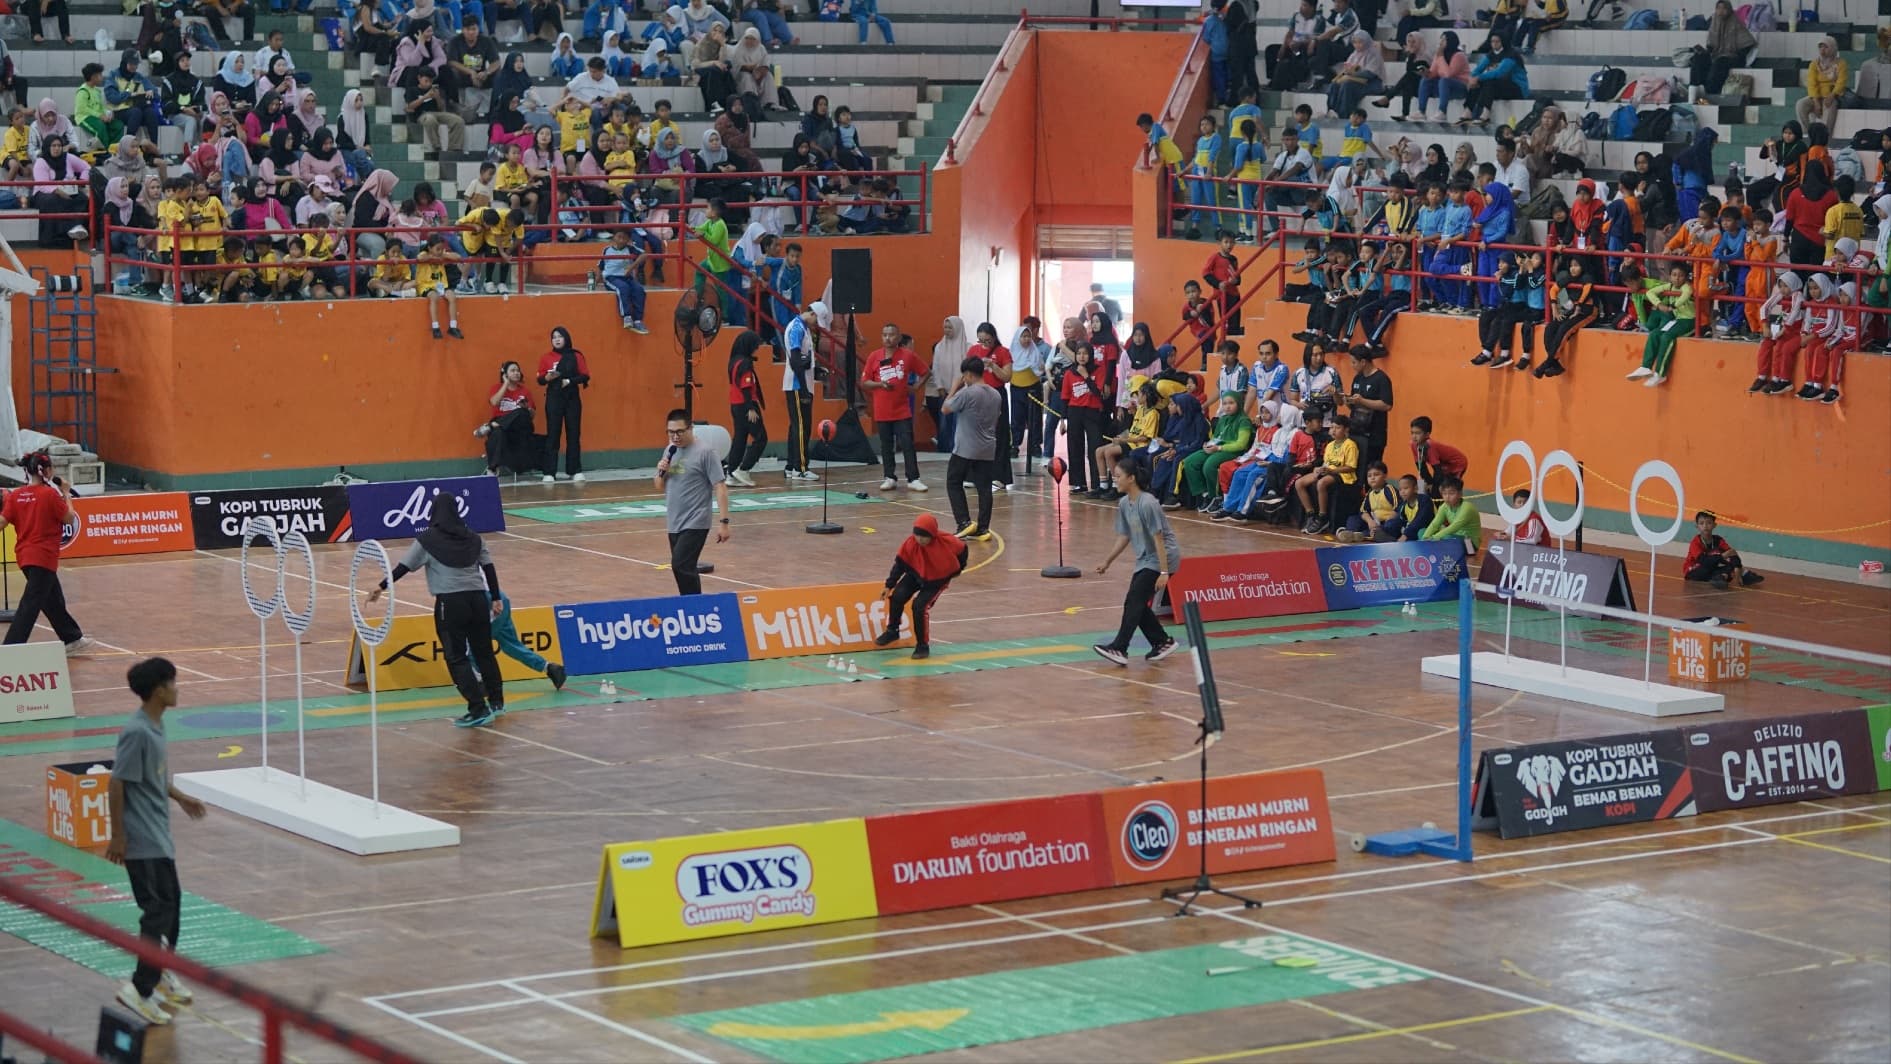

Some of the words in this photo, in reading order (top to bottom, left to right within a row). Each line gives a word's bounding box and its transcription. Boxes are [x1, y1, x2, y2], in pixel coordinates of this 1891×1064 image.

[88, 512, 139, 524] BENERAN
[141, 510, 178, 521] MURNI
[220, 501, 257, 514] KOPI
[259, 497, 323, 512] TUBRUK
[86, 525, 138, 537] BENERAN
[140, 522, 183, 534] RINGAN
[221, 512, 326, 536] GAJAH
[1238, 579, 1311, 599] foundation
[577, 609, 723, 650] hydroplus
[666, 645, 702, 655] ISOTONIC
[703, 642, 727, 652] DRINK
[1672, 636, 1704, 660] Milk
[1712, 638, 1745, 660] Milk
[1677, 656, 1705, 679] Life
[1717, 657, 1747, 679] Life
[1753, 724, 1803, 743] DELIZIO
[1566, 748, 1598, 765] KOPI
[1599, 742, 1654, 760] TUBRUK
[1569, 755, 1659, 786] GADJAH
[48, 786, 73, 818] Milk
[1573, 790, 1617, 807] BENAR
[1620, 785, 1662, 801] BENAR
[1187, 802, 1259, 825] BENERAN
[1261, 797, 1309, 817] MURNI
[1605, 803, 1636, 817] KOPI
[53, 812, 74, 842] Life
[1133, 823, 1169, 850] Cleo
[1187, 824, 1258, 846] BENERAN
[1259, 817, 1317, 837] RINGAN
[951, 835, 979, 849] Bakti
[980, 830, 1027, 846] Olahraga
[893, 855, 973, 884] DJARUM
[976, 840, 1090, 874] foundation
[692, 855, 799, 898] FOX'S
[684, 902, 755, 926] Gummy
[756, 892, 815, 917] Candy
